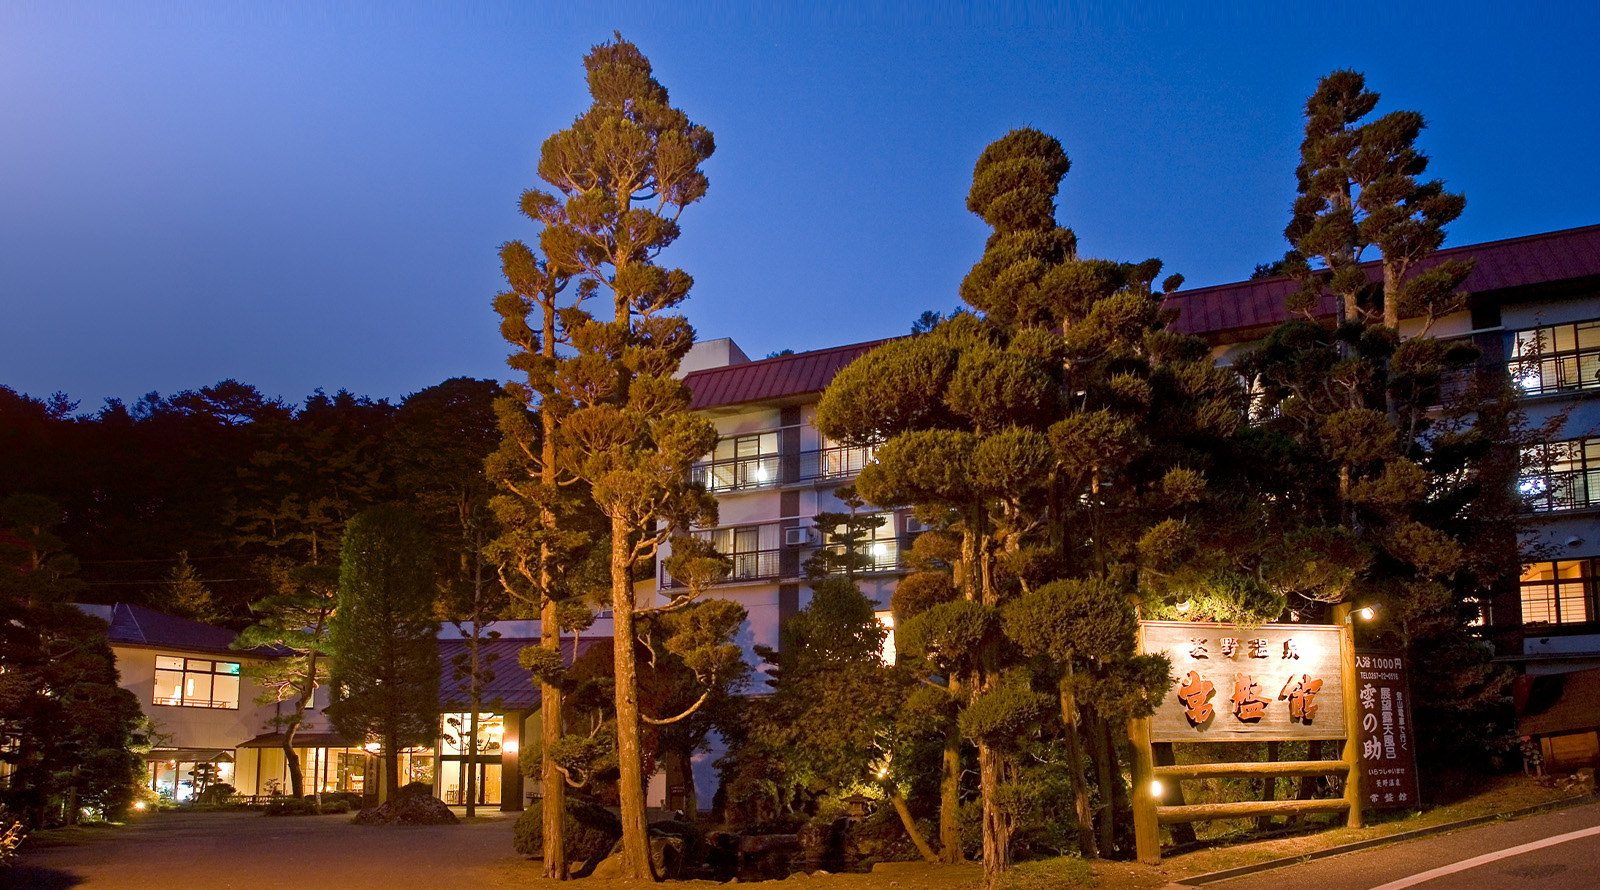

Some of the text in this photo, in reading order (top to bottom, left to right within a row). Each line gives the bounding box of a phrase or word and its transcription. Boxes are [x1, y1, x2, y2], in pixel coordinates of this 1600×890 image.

[1360, 682, 1382, 760] 雲の助
[1380, 687, 1397, 759] 展望露天風呂
[1368, 768, 1405, 776] いらっしゃいませ
